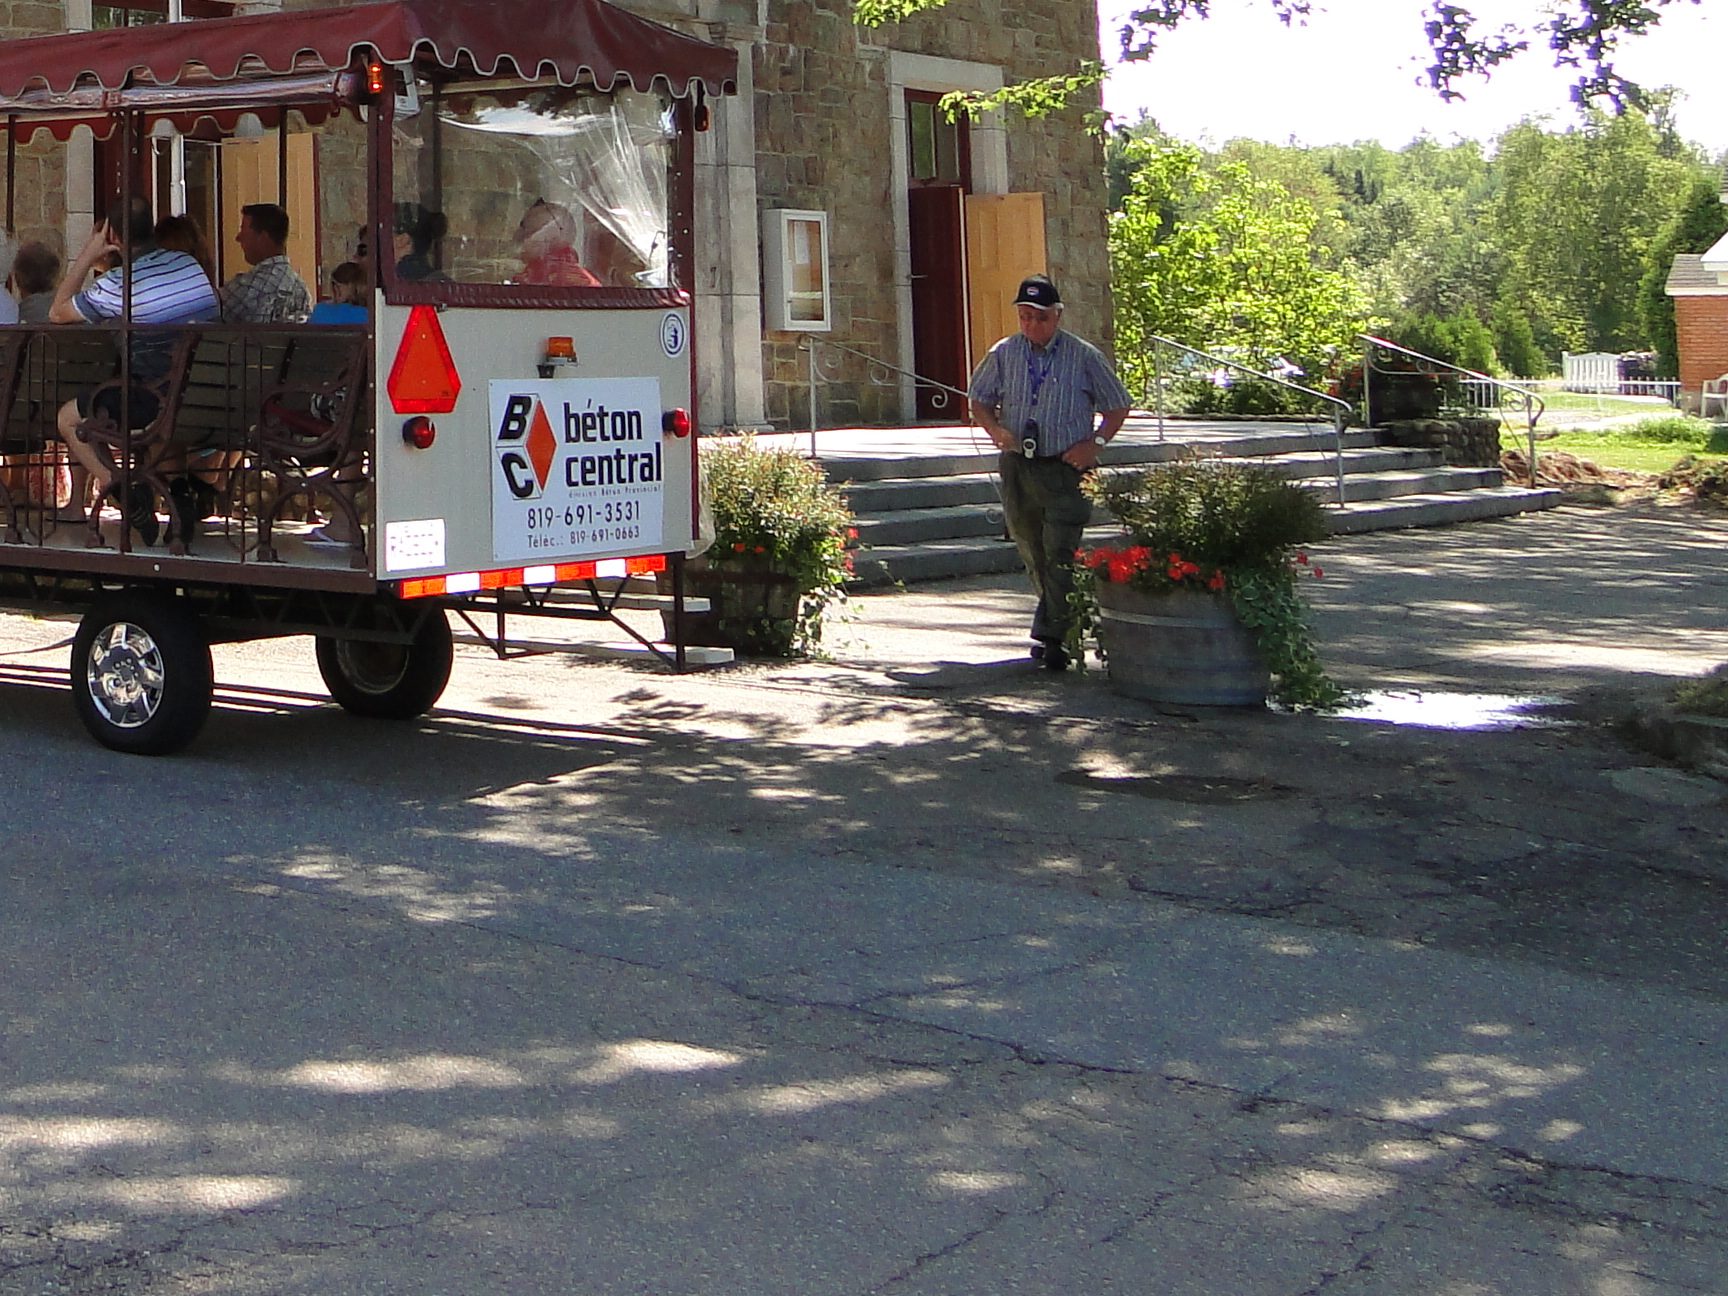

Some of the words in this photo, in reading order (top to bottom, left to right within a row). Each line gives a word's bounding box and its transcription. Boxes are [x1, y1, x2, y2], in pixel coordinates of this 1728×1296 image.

[563, 398, 643, 443] béton
[565, 442, 662, 487] central
[527, 500, 640, 529] 819-691-3531
[570, 525, 640, 545] 819-691-0663
